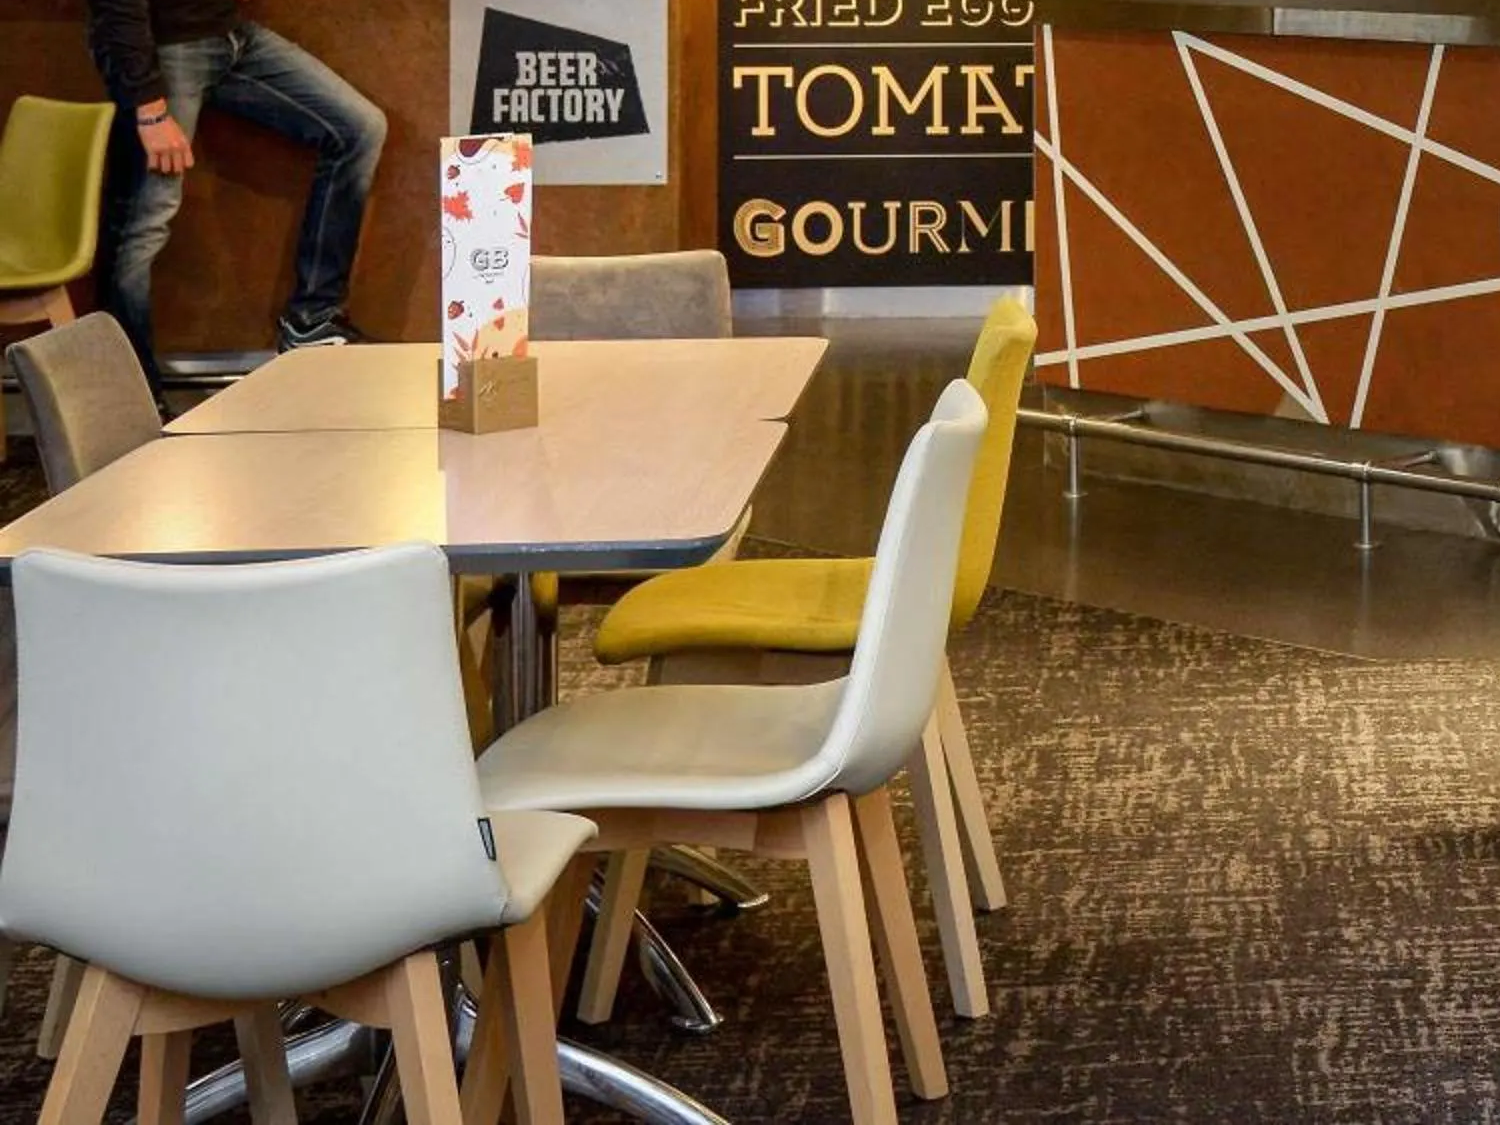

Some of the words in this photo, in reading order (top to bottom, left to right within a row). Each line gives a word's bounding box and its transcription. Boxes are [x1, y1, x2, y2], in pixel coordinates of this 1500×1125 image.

[515, 51, 598, 87] BEER
[493, 87, 625, 123] FACTORY
[733, 198, 1035, 258] GOURM
[470, 247, 510, 271] GB
